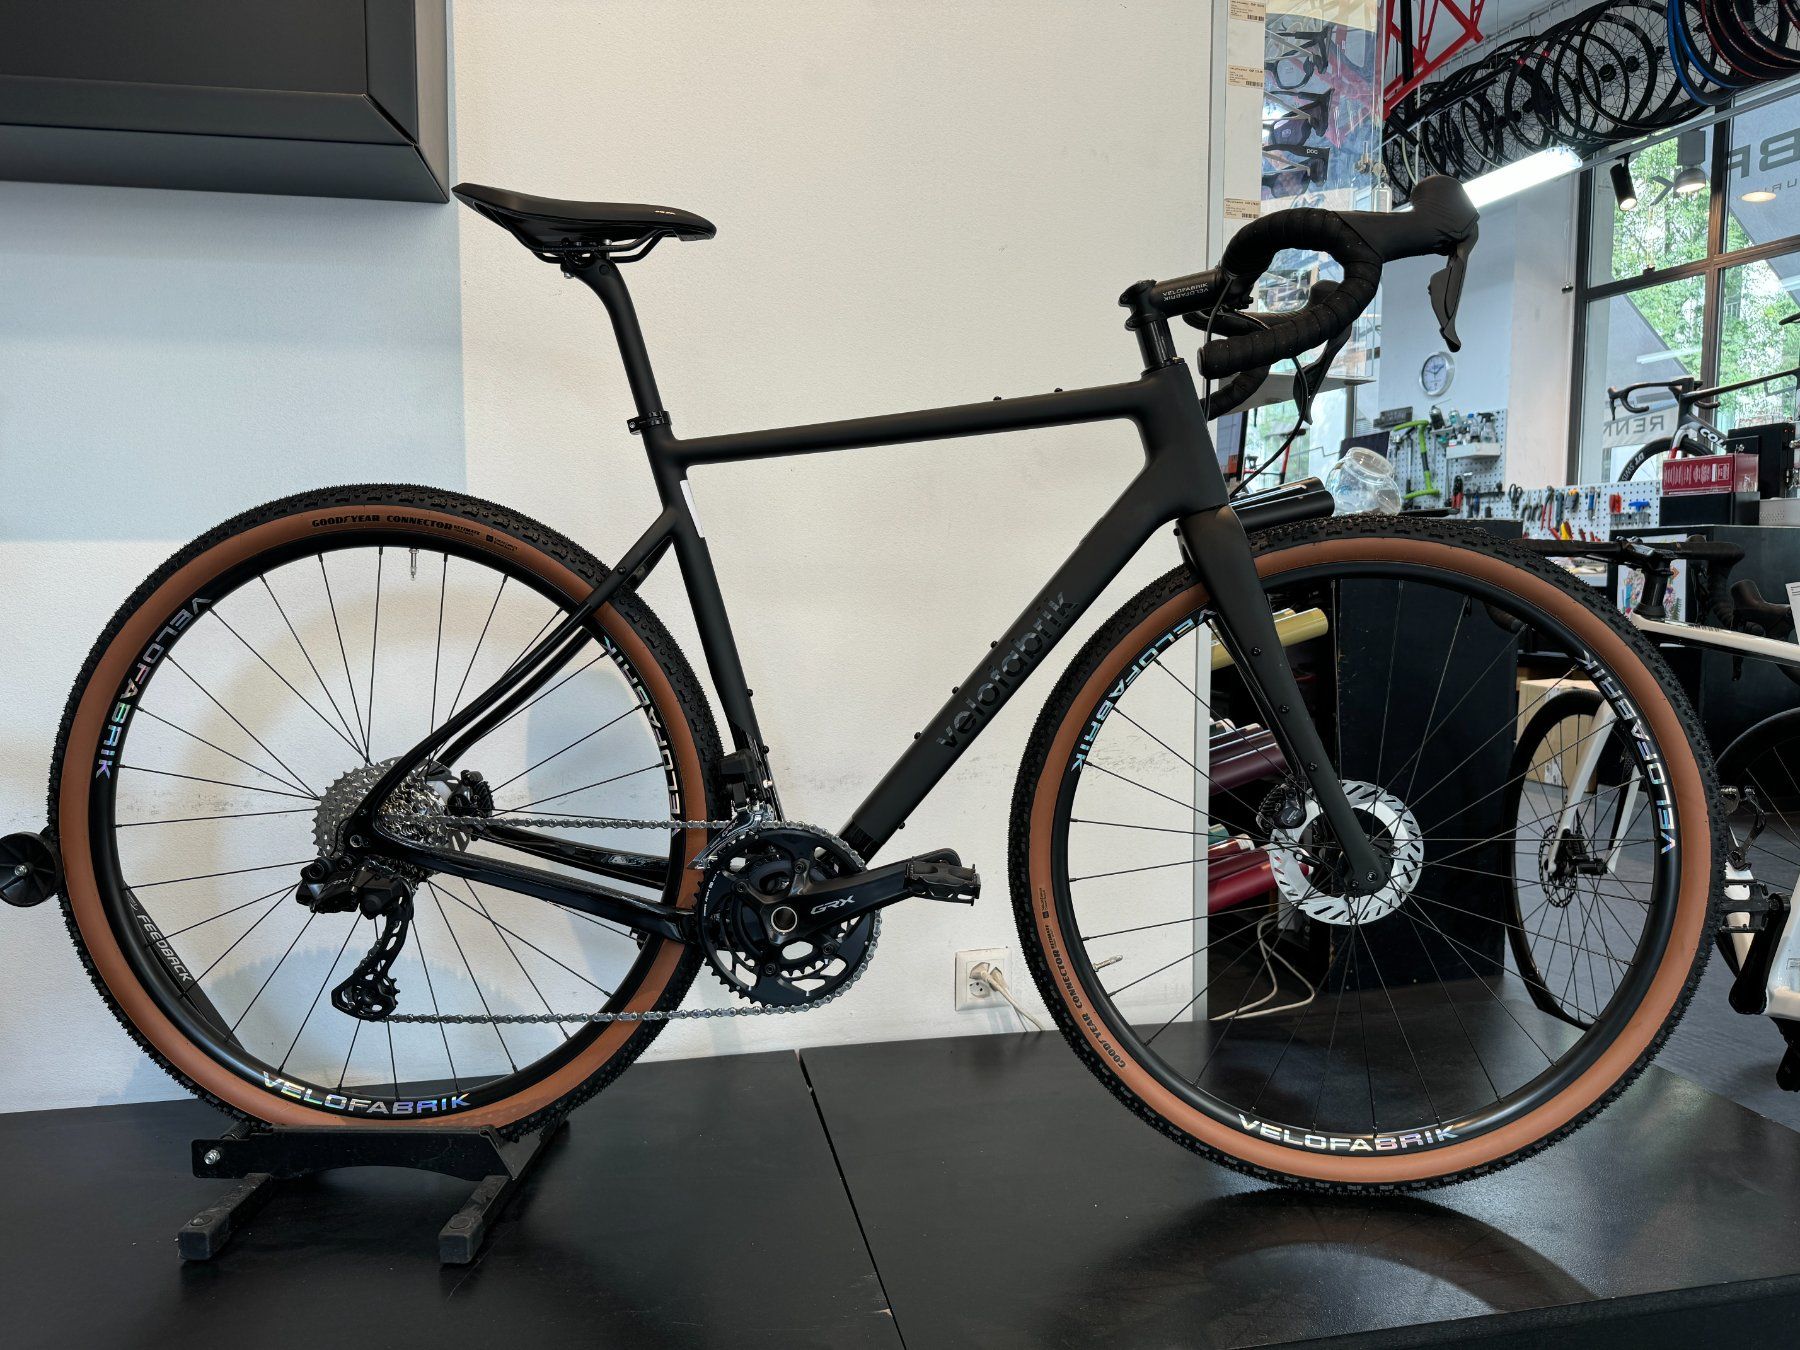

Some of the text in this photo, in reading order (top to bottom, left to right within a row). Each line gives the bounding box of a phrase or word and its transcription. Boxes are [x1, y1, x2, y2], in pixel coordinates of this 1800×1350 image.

[1162, 282, 1208, 297] VELOFABRIK
[311, 514, 381, 528] GOODYEAR
[386, 515, 453, 530] CONNECTOR
[95, 597, 212, 780] VELOFABRIK
[936, 592, 1079, 748] velofabrik
[1071, 609, 1216, 773] VELOFABRIK
[1575, 649, 1676, 855] VELOFABRIK
[810, 895, 856, 915] GRX
[136, 914, 193, 982] FEEDBACK
[1052, 949, 1083, 1009] CONNECTOR
[1081, 1012, 1126, 1069] GOODYEAR
[262, 1070, 472, 1115] VELOFABRIK
[1238, 1113, 1459, 1152] VELOFABRIK
